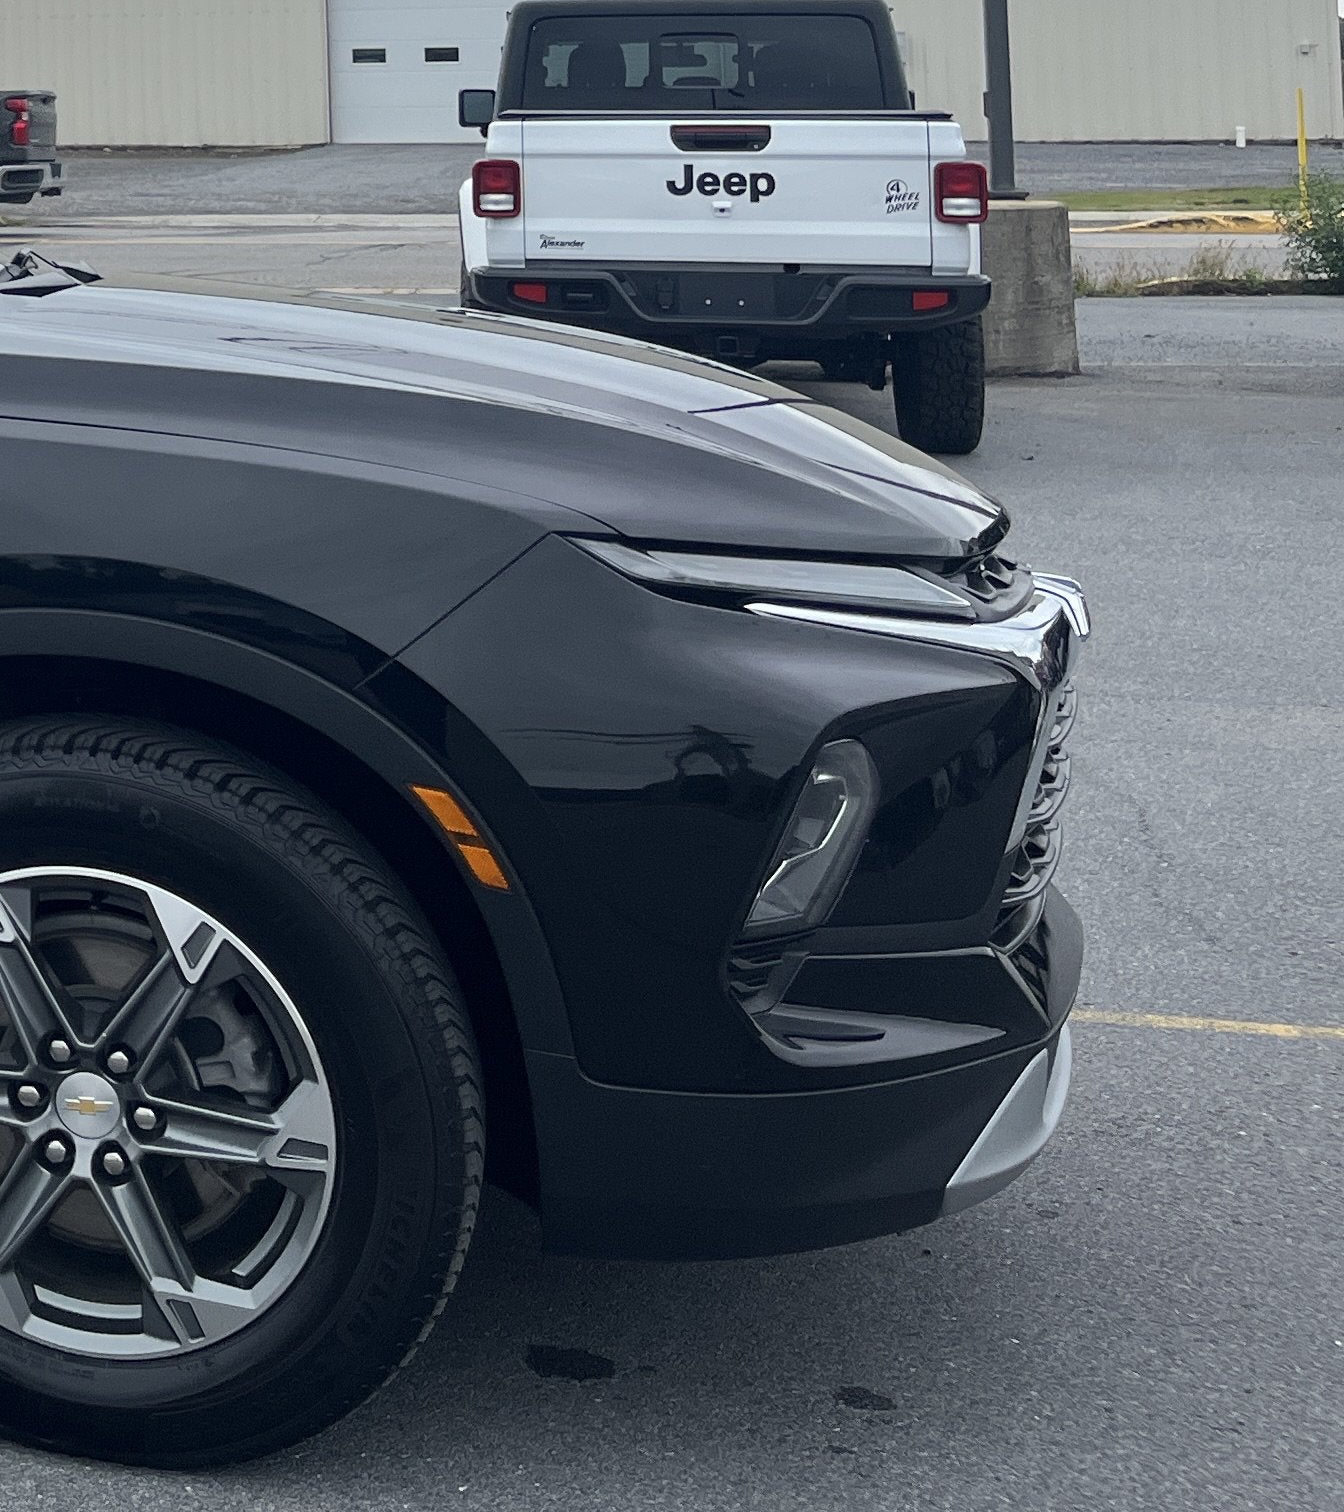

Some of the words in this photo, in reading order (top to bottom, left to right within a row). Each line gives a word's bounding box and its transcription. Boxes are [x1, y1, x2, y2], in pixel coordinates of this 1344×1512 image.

[666, 164, 776, 203] Jeep
[885, 192, 919, 204] WHEEL
[886, 201, 919, 214] DRIVE
